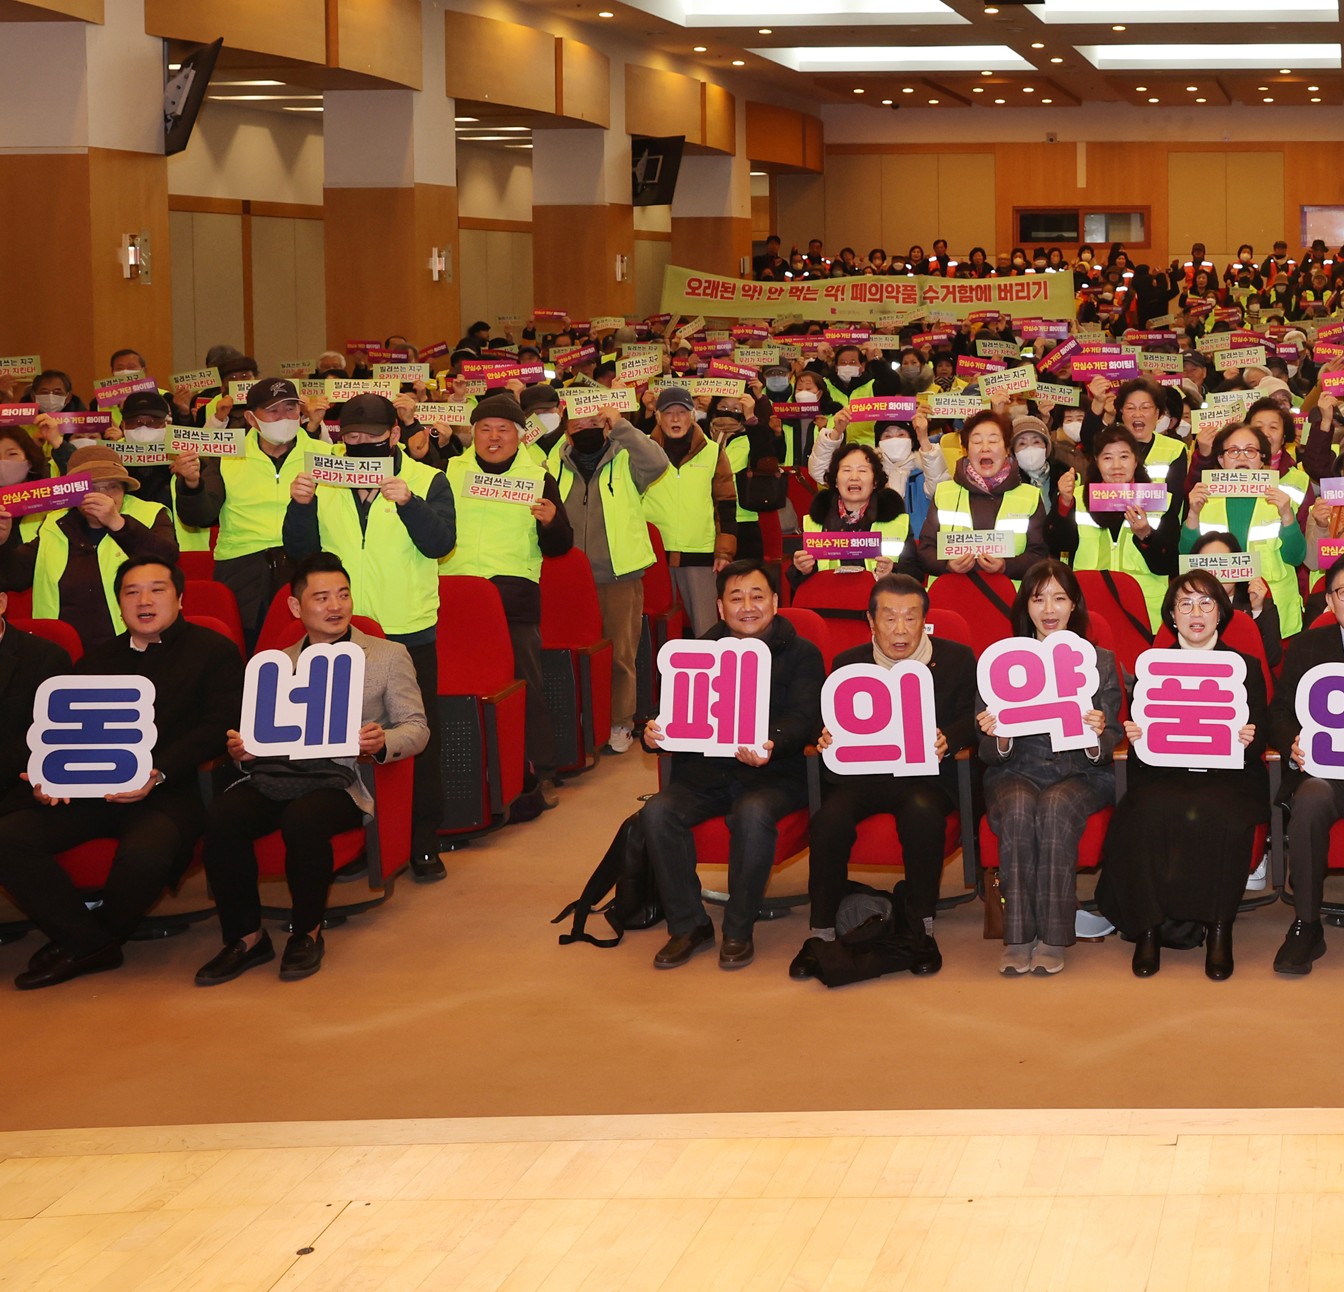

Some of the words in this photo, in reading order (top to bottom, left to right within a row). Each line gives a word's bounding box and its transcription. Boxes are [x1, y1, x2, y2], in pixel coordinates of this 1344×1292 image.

[685, 277, 736, 299] 오래된
[741, 281, 761, 301] 약!
[767, 286, 784, 302] 안
[788, 284, 820, 302] 먹는
[823, 282, 845, 302] 약!
[851, 281, 916, 304] 폐의약품
[923, 281, 991, 303] 수거함에
[996, 280, 1048, 302] 버리기
[1220, 351, 1244, 361] 빌려쓰는
[1247, 349, 1259, 357] 지구
[713, 362, 739, 373] 안심수거단
[739, 369, 756, 378] 화이팅!
[959, 360, 985, 369] 안심수거단
[986, 363, 1005, 372] 화이팅!
[1073, 362, 1107, 370] 안심수거단
[1109, 360, 1134, 369] 화이팅!
[487, 369, 520, 380] 안심수거단
[521, 366, 542, 375] 화이팅!
[984, 373, 1009, 386] 빌려쓰는
[1013, 369, 1027, 380] 지구
[98, 386, 131, 400] 안심수거단
[133, 382, 155, 391] 화이팅!
[334, 381, 368, 389] 빌려쓰는
[372, 381, 390, 389] 지구
[574, 394, 608, 405] 빌려쓰는
[611, 391, 627, 400] 지구
[1214, 394, 1242, 402] 빌려쓰는
[1246, 392, 1261, 400] 지구
[1, 408, 35, 416] 화이팅!
[852, 403, 887, 412] 안심수거단
[888, 402, 914, 411] 화이팅!
[1200, 410, 1229, 420] 빌려쓰는
[1231, 404, 1241, 412] 지구
[174, 429, 210, 441] 빌려쓰는
[214, 432, 234, 441] 지구
[172, 442, 199, 452] 우리가
[203, 444, 236, 454] 지킨다!
[314, 456, 355, 470] 빌려쓰는
[359, 459, 381, 470] 지구
[474, 475, 512, 487] 빌려쓰는
[516, 481, 534, 490] 지구
[1211, 471, 1246, 482] 빌려쓰는
[1251, 472, 1270, 482] 지구
[2, 488, 50, 504] 안심수거단
[52, 481, 88, 495] 화이팅!
[470, 486, 504, 499] 우리가
[507, 490, 534, 502] 지킨다!
[1092, 490, 1134, 499] 안심수거단
[1136, 490, 1164, 499] 화이팅!
[806, 538, 849, 548] 안심수거단
[850, 538, 879, 548] 화이팅!
[947, 534, 983, 543] 빌려쓰는
[986, 532, 1006, 542] 지구
[1189, 556, 1228, 567] 빌려쓰는
[1231, 556, 1251, 566] 지구
[1221, 568, 1253, 578] 지킨다!
[669, 650, 758, 745] 폐
[990, 643, 1087, 738] 약
[254, 653, 352, 746] 네
[1145, 661, 1236, 756] 품
[833, 673, 925, 764] 의
[41, 688, 143, 784] 동
